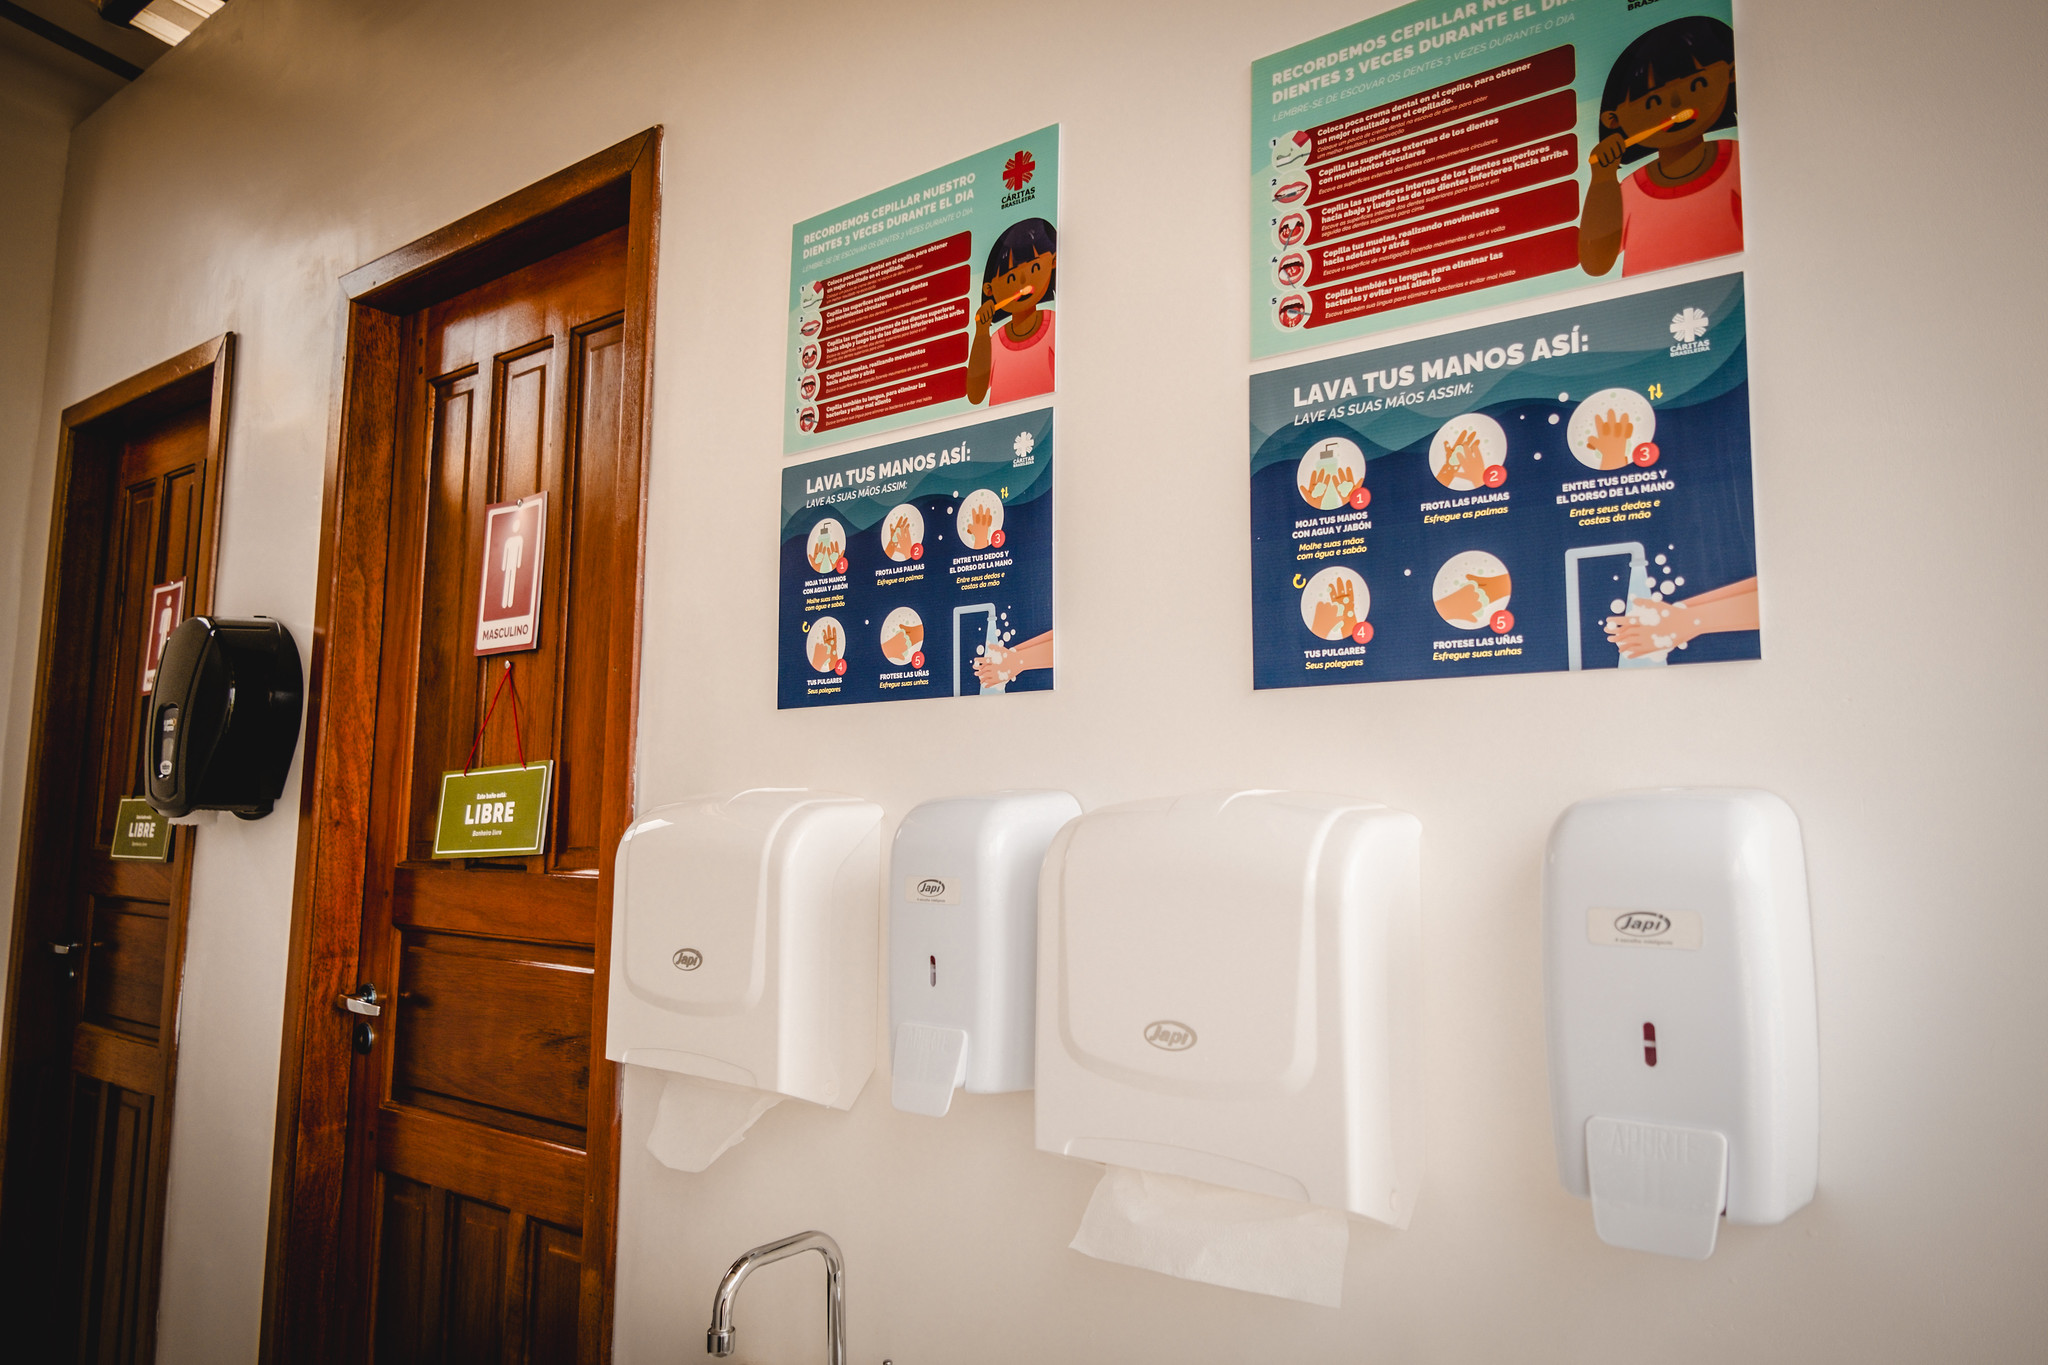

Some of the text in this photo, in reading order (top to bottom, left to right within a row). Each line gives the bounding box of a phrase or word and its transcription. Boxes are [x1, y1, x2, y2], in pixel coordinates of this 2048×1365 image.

[1272, 2, 1478, 87] RECORDEMOS CEPILLAR
[1272, 3, 1537, 105] DIENTES 3 VECES DURANTE EL
[1317, 63, 1531, 137] Coloca poca crema dental en el cepillo, para obtener
[1317, 98, 1454, 146] un mejor resultado en el cepillado.
[1318, 164, 1346, 177] Cepilla
[1347, 160, 1359, 169] las
[1401, 136, 1438, 152] externas
[1439, 132, 1451, 141] de
[1451, 128, 1465, 137] los
[1466, 117, 1499, 133] dientes
[1318, 148, 1426, 186] con movimientos circulares
[1001, 186, 1036, 204] CÁRITAS
[803, 172, 976, 246] RECORDEMOS CEPILLAR NUESTRO
[803, 188, 974, 260] DIENTES 3 VECES DURANTE EL DIA
[1670, 339, 1710, 353] CÁRITAS
[1293, 325, 1589, 408] LAVA TUS MANOS ASÍ:
[1294, 382, 1471, 426] LAVE AS SUAS MÃOS ASSIM:
[1640, 447, 1650, 462] 3
[806, 440, 971, 495] LAVA TUS MANOS ASÍ:
[1489, 470, 1499, 482] 2
[1562, 469, 1668, 493] ENTRE TUS DEDOS Y
[806, 480, 907, 509] LAVE AS SUAS MÃOS ASSIM:
[1356, 493, 1364, 504] 1
[1556, 480, 1675, 505] EL DORSO DE LA MANO
[1420, 491, 1510, 512] FROTA LAS PALMAS
[1569, 499, 1661, 518] Entre seus dedos e
[1295, 511, 1368, 529] MOJA TUS MANOS
[1423, 506, 1509, 525] Esfregue as palmas
[1578, 510, 1652, 527] costas da mão
[1292, 520, 1372, 539] CON AGUA Y JABÓN
[995, 533, 1001, 544] 3
[1298, 537, 1365, 552] Molhe suas mãos
[914, 546, 920, 556] 2
[952, 556, 972, 565] ENTRE
[971, 554, 984, 562] TUS
[984, 551, 1005, 561] DEDOS
[1296, 553, 1314, 561] com
[1314, 550, 1335, 560] água
[1342, 545, 1368, 555] sabão
[840, 561, 845, 570] 1
[875, 563, 925, 577] FROTA LAS PALMAS
[957, 563, 978, 573] DORSO
[977, 562, 986, 570] DE
[986, 561, 994, 569] LA
[994, 558, 1013, 568] MANO
[1496, 616, 1506, 630] 5
[482, 624, 529, 641] MASCULINO
[1357, 626, 1366, 638] 4
[1433, 634, 1524, 650] FROTESE LAS UÑAS
[915, 655, 921, 666] 5
[1304, 646, 1366, 659] TUS PULGARES
[1432, 647, 1522, 662] Esfregue suas unhas
[837, 662, 843, 671] 4
[1305, 659, 1364, 670] Seus polegares
[817, 677, 843, 685] PULGARES
[879, 669, 930, 681] FROTESE LAS UÑAS
[464, 801, 516, 825] LIBRE
[128, 822, 156, 838] LIBRE
[920, 880, 942, 895] Japi
[1620, 914, 1663, 933] Japi
[675, 950, 700, 968] Japi
[1148, 1024, 1190, 1047] Japi
